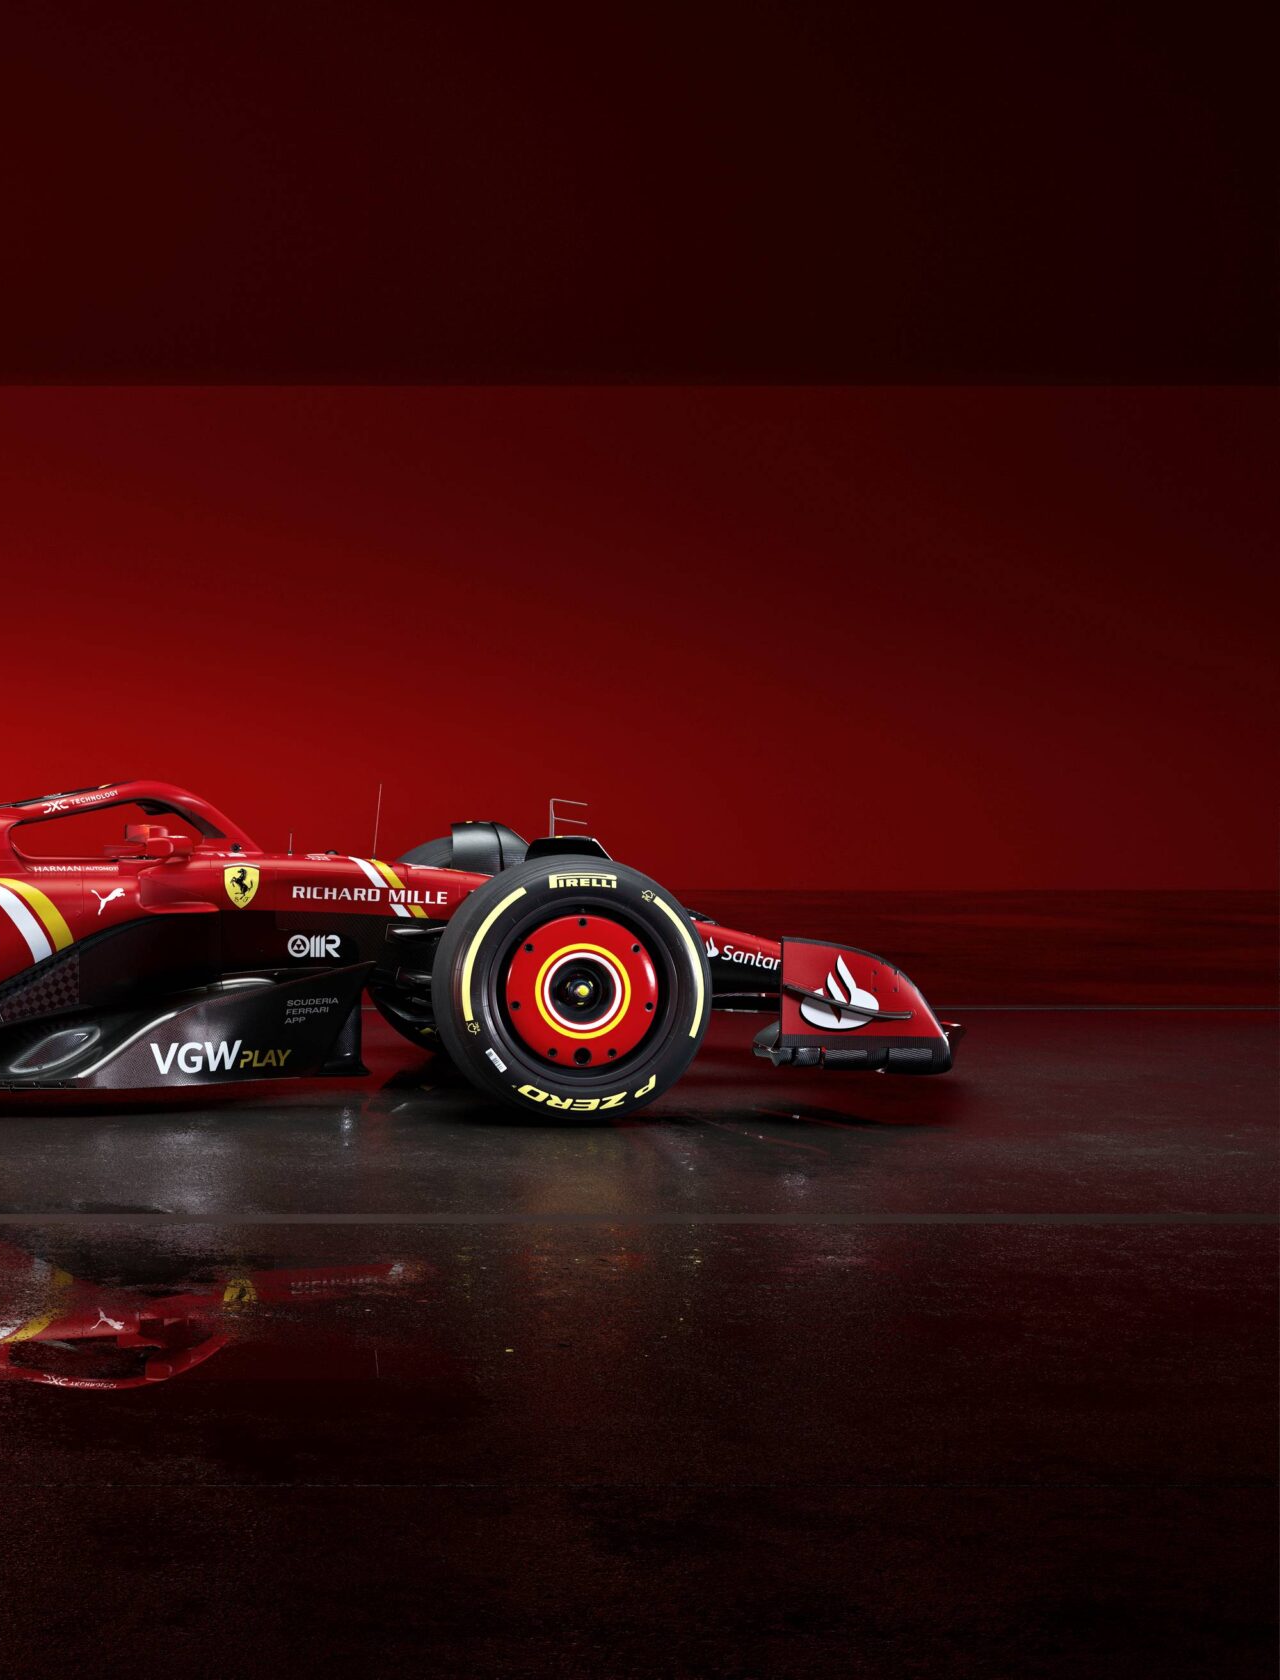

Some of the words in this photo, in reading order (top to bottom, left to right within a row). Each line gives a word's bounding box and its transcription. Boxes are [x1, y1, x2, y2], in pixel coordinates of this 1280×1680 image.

[70, 790, 119, 805] TECHNOLOGY
[548, 872, 618, 888] PIRELLI
[292, 886, 381, 902] RICHARD
[388, 889, 448, 905] MILLE
[286, 997, 339, 1007] SCUDERIA
[286, 1006, 329, 1016] FERRARI
[284, 1016, 306, 1024] APP
[150, 1039, 242, 1074] VGW
[240, 1049, 292, 1068] PLAY
[634, 1074, 656, 1098] P
[517, 1084, 628, 1111] ZERO
